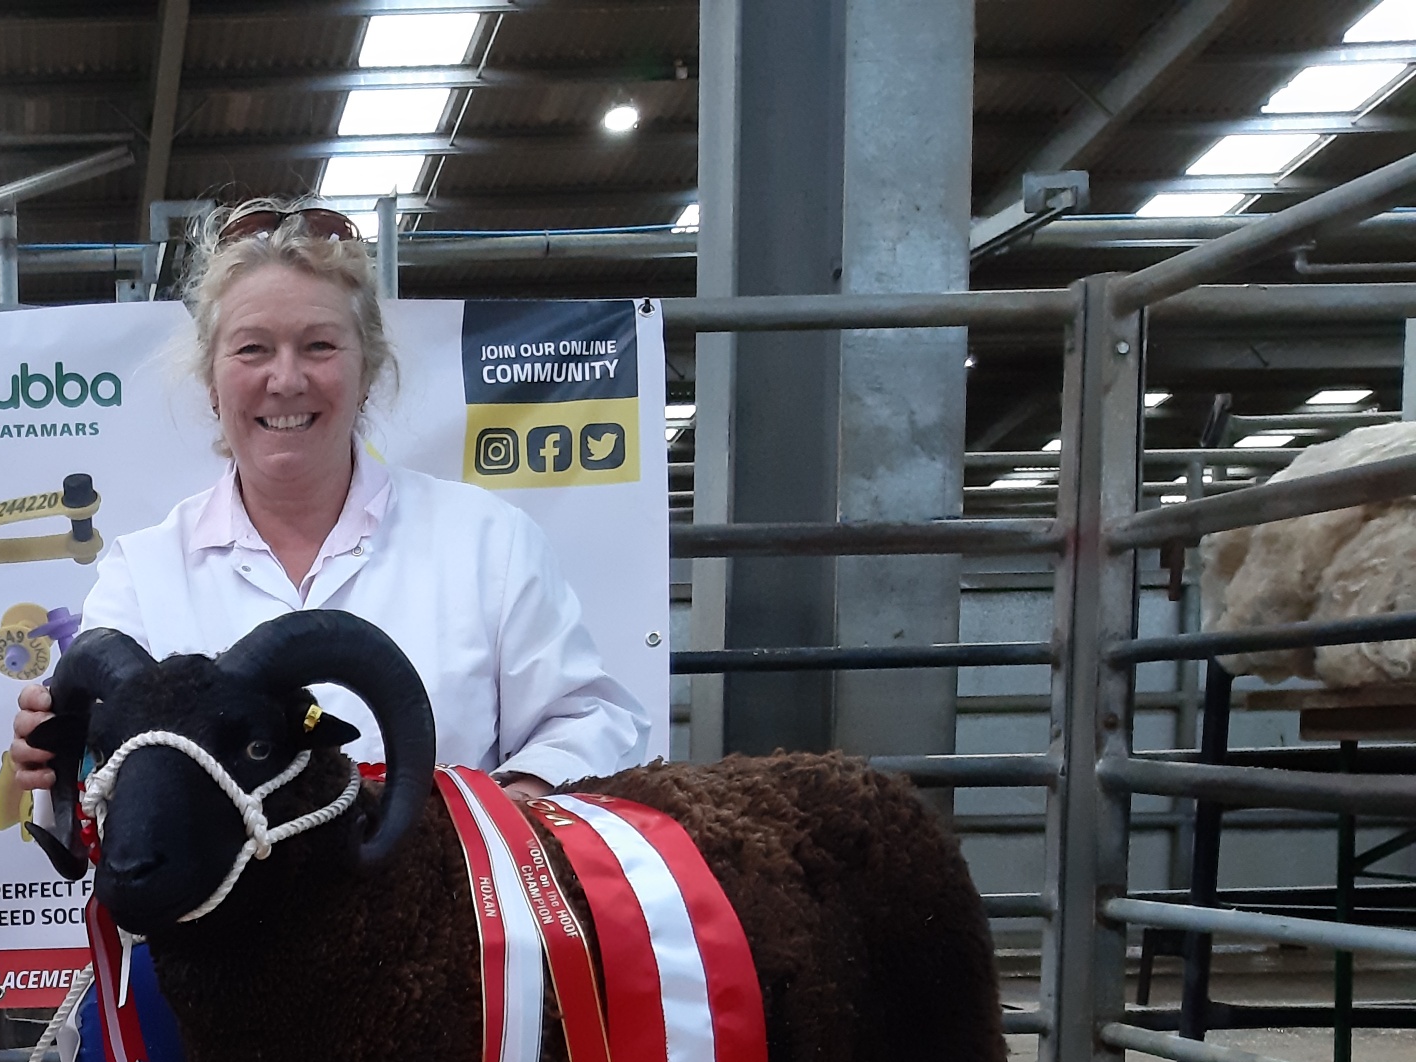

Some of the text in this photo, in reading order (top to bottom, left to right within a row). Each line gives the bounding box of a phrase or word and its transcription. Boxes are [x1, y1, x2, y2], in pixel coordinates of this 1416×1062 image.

[481, 340, 617, 361] JOIN OUR ONLINE
[482, 359, 620, 384] COMMUNITY
[82, 880, 92, 897] F
[520, 864, 556, 926] CHAMPION
[526, 838, 546, 873] WOOL
[539, 873, 551, 888] on
[555, 909, 580, 939] HOOF
[41, 907, 85, 925] SOCI
